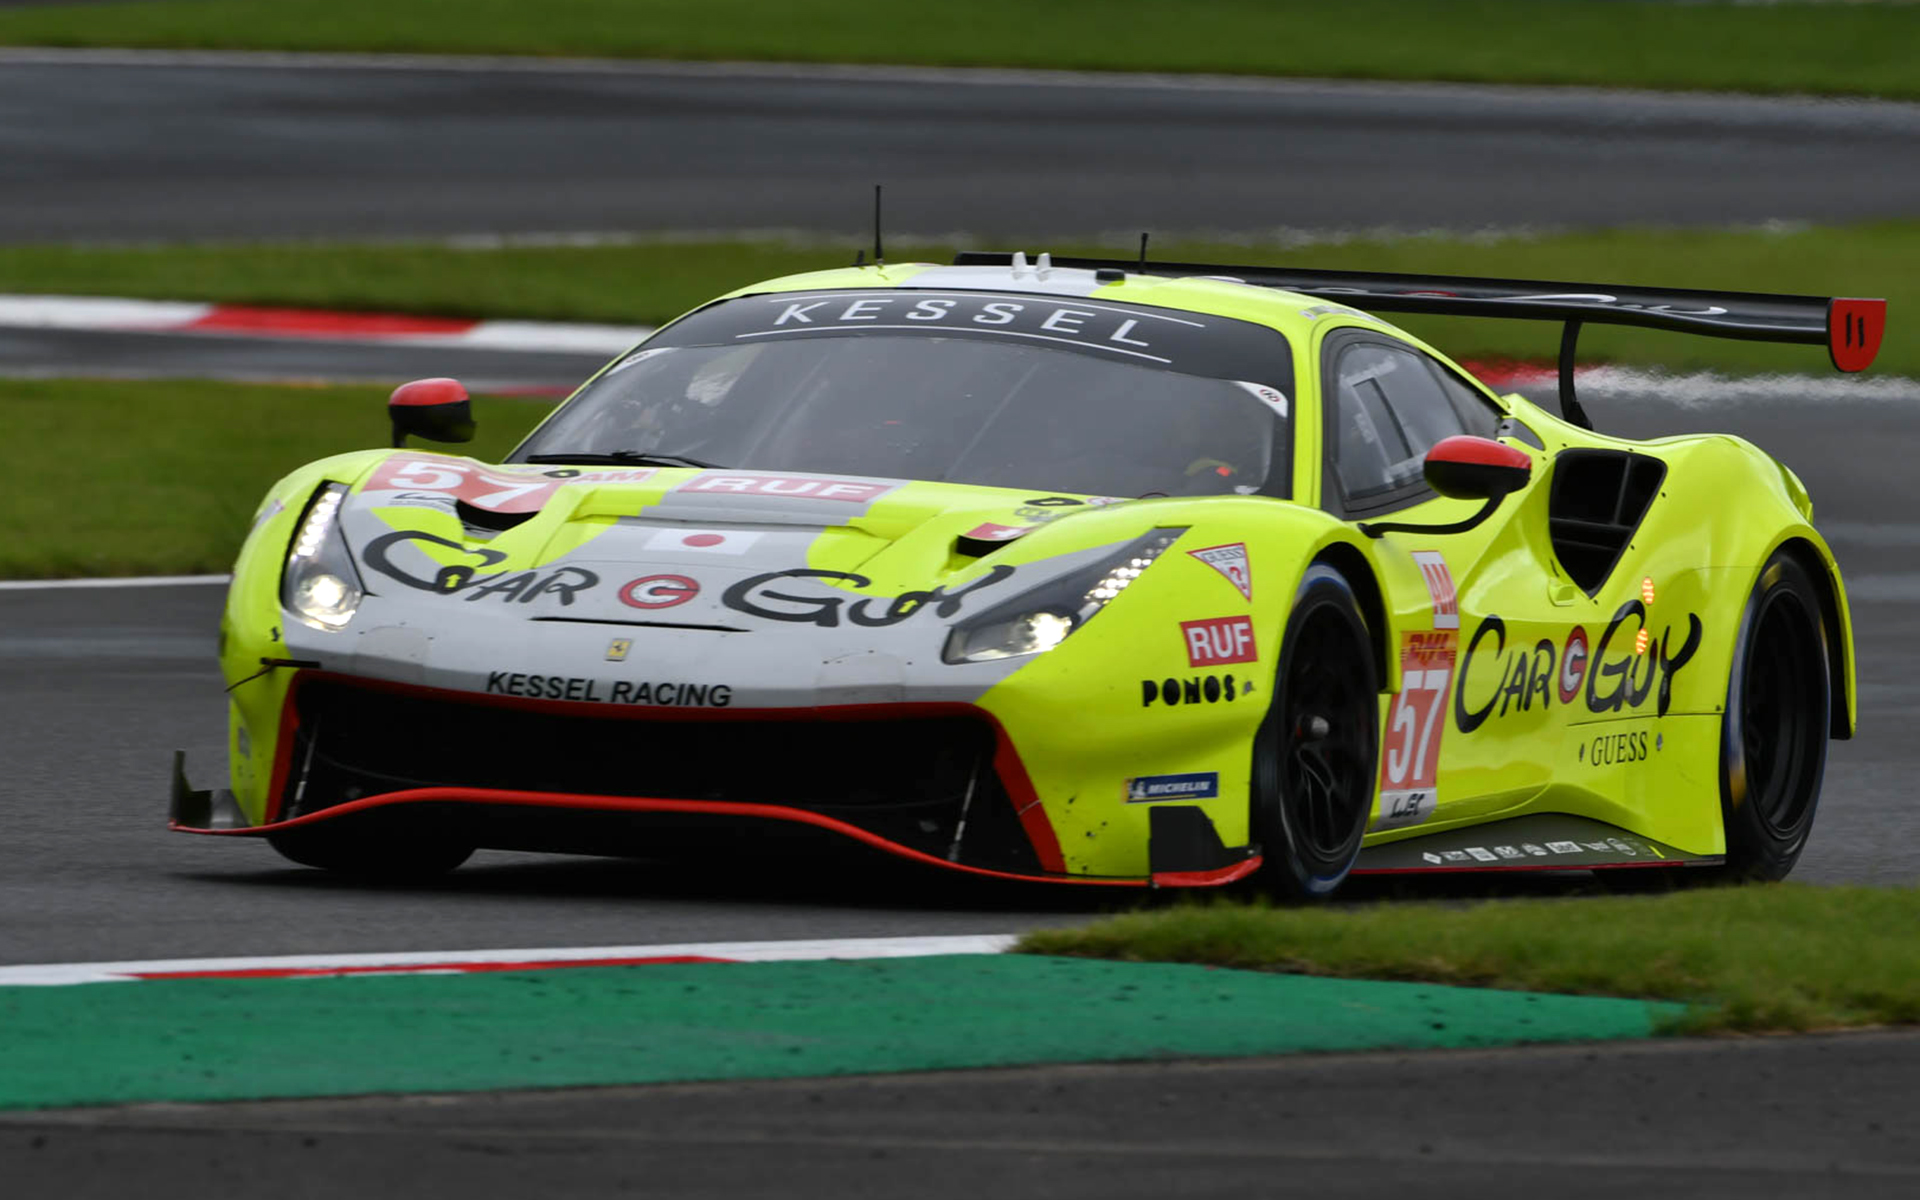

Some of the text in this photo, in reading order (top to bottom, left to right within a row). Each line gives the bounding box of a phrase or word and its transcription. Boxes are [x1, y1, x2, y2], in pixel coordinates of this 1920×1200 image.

[773, 298, 1149, 347] KESSEL
[389, 461, 549, 508] 57
[696, 477, 875, 497] RUF
[1187, 622, 1250, 660] RUF
[1455, 614, 1556, 733] CAR
[1586, 599, 1702, 718] GUY
[487, 671, 732, 707] KESSEL RACING
[1141, 674, 1235, 707] PONOS
[1387, 669, 1449, 784] 57
[1590, 731, 1648, 766] GUESS
[1147, 781, 1210, 794] MICHELIN
